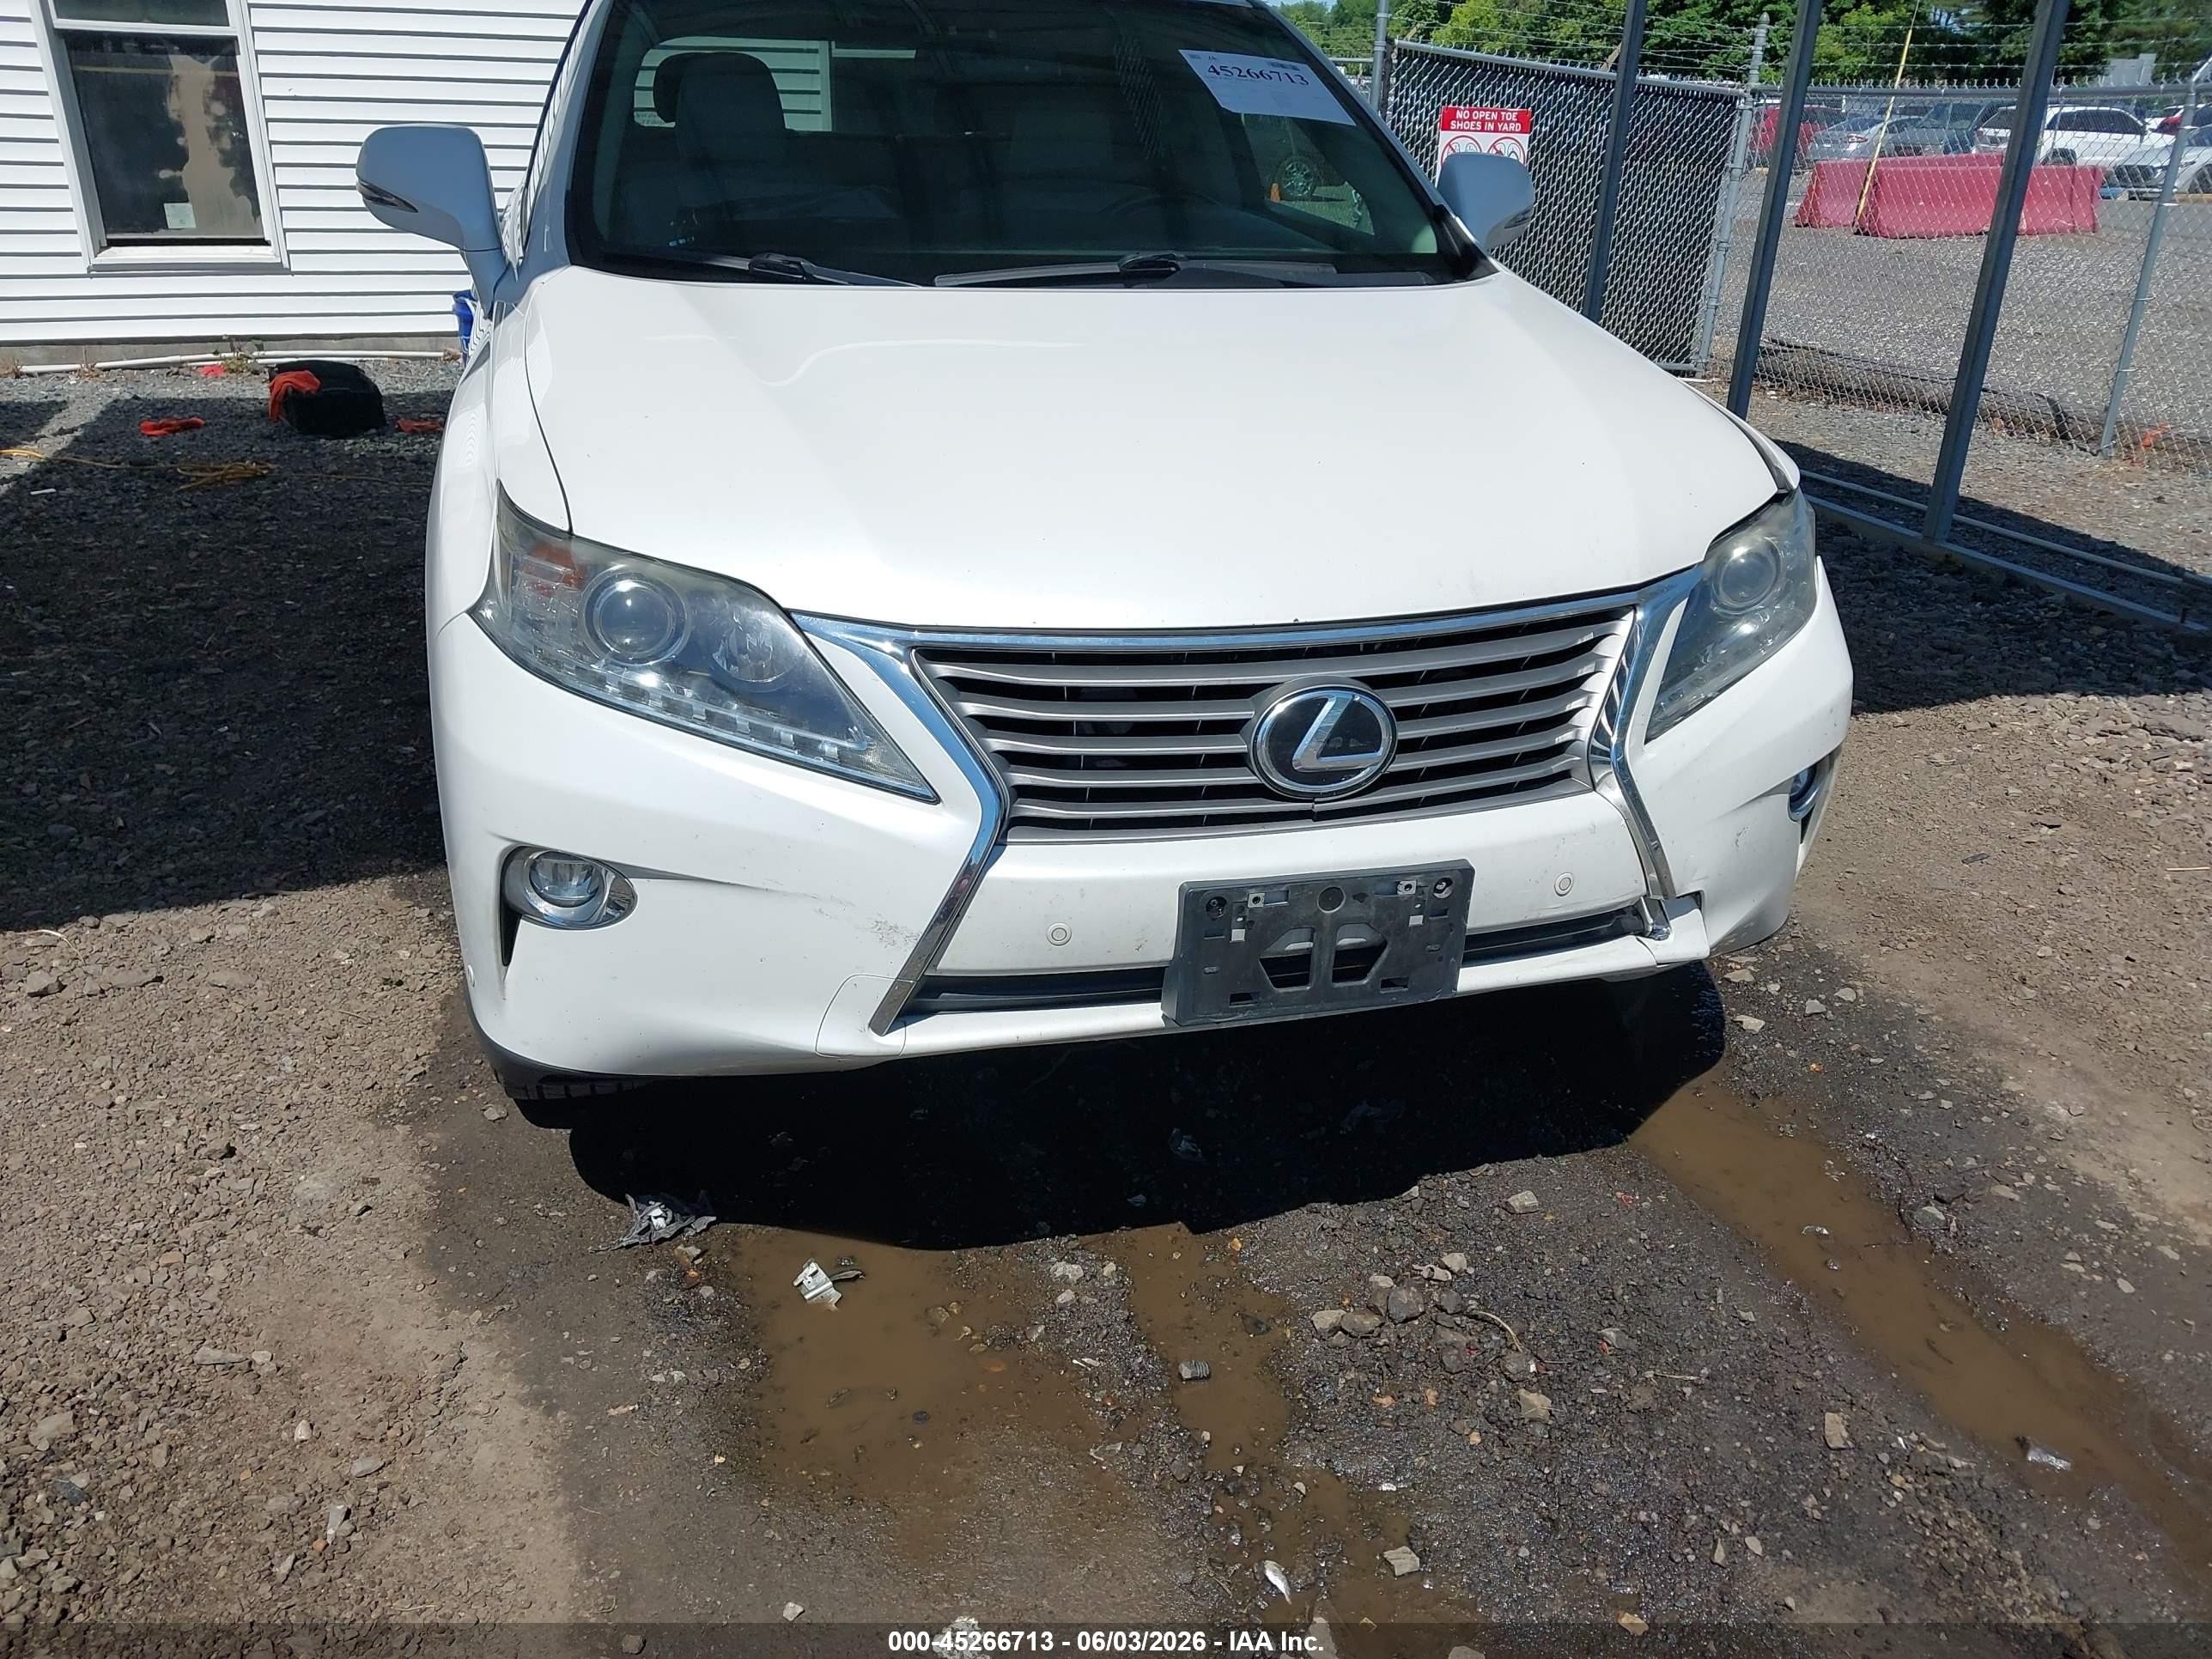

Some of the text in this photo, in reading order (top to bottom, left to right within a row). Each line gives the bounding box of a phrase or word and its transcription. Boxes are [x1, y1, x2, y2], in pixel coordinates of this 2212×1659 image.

[1207, 64, 1310, 85] 45266713
[1455, 109, 1518, 121] NO OPEN TOE
[1449, 120, 1522, 131] SHOES IN YARD
